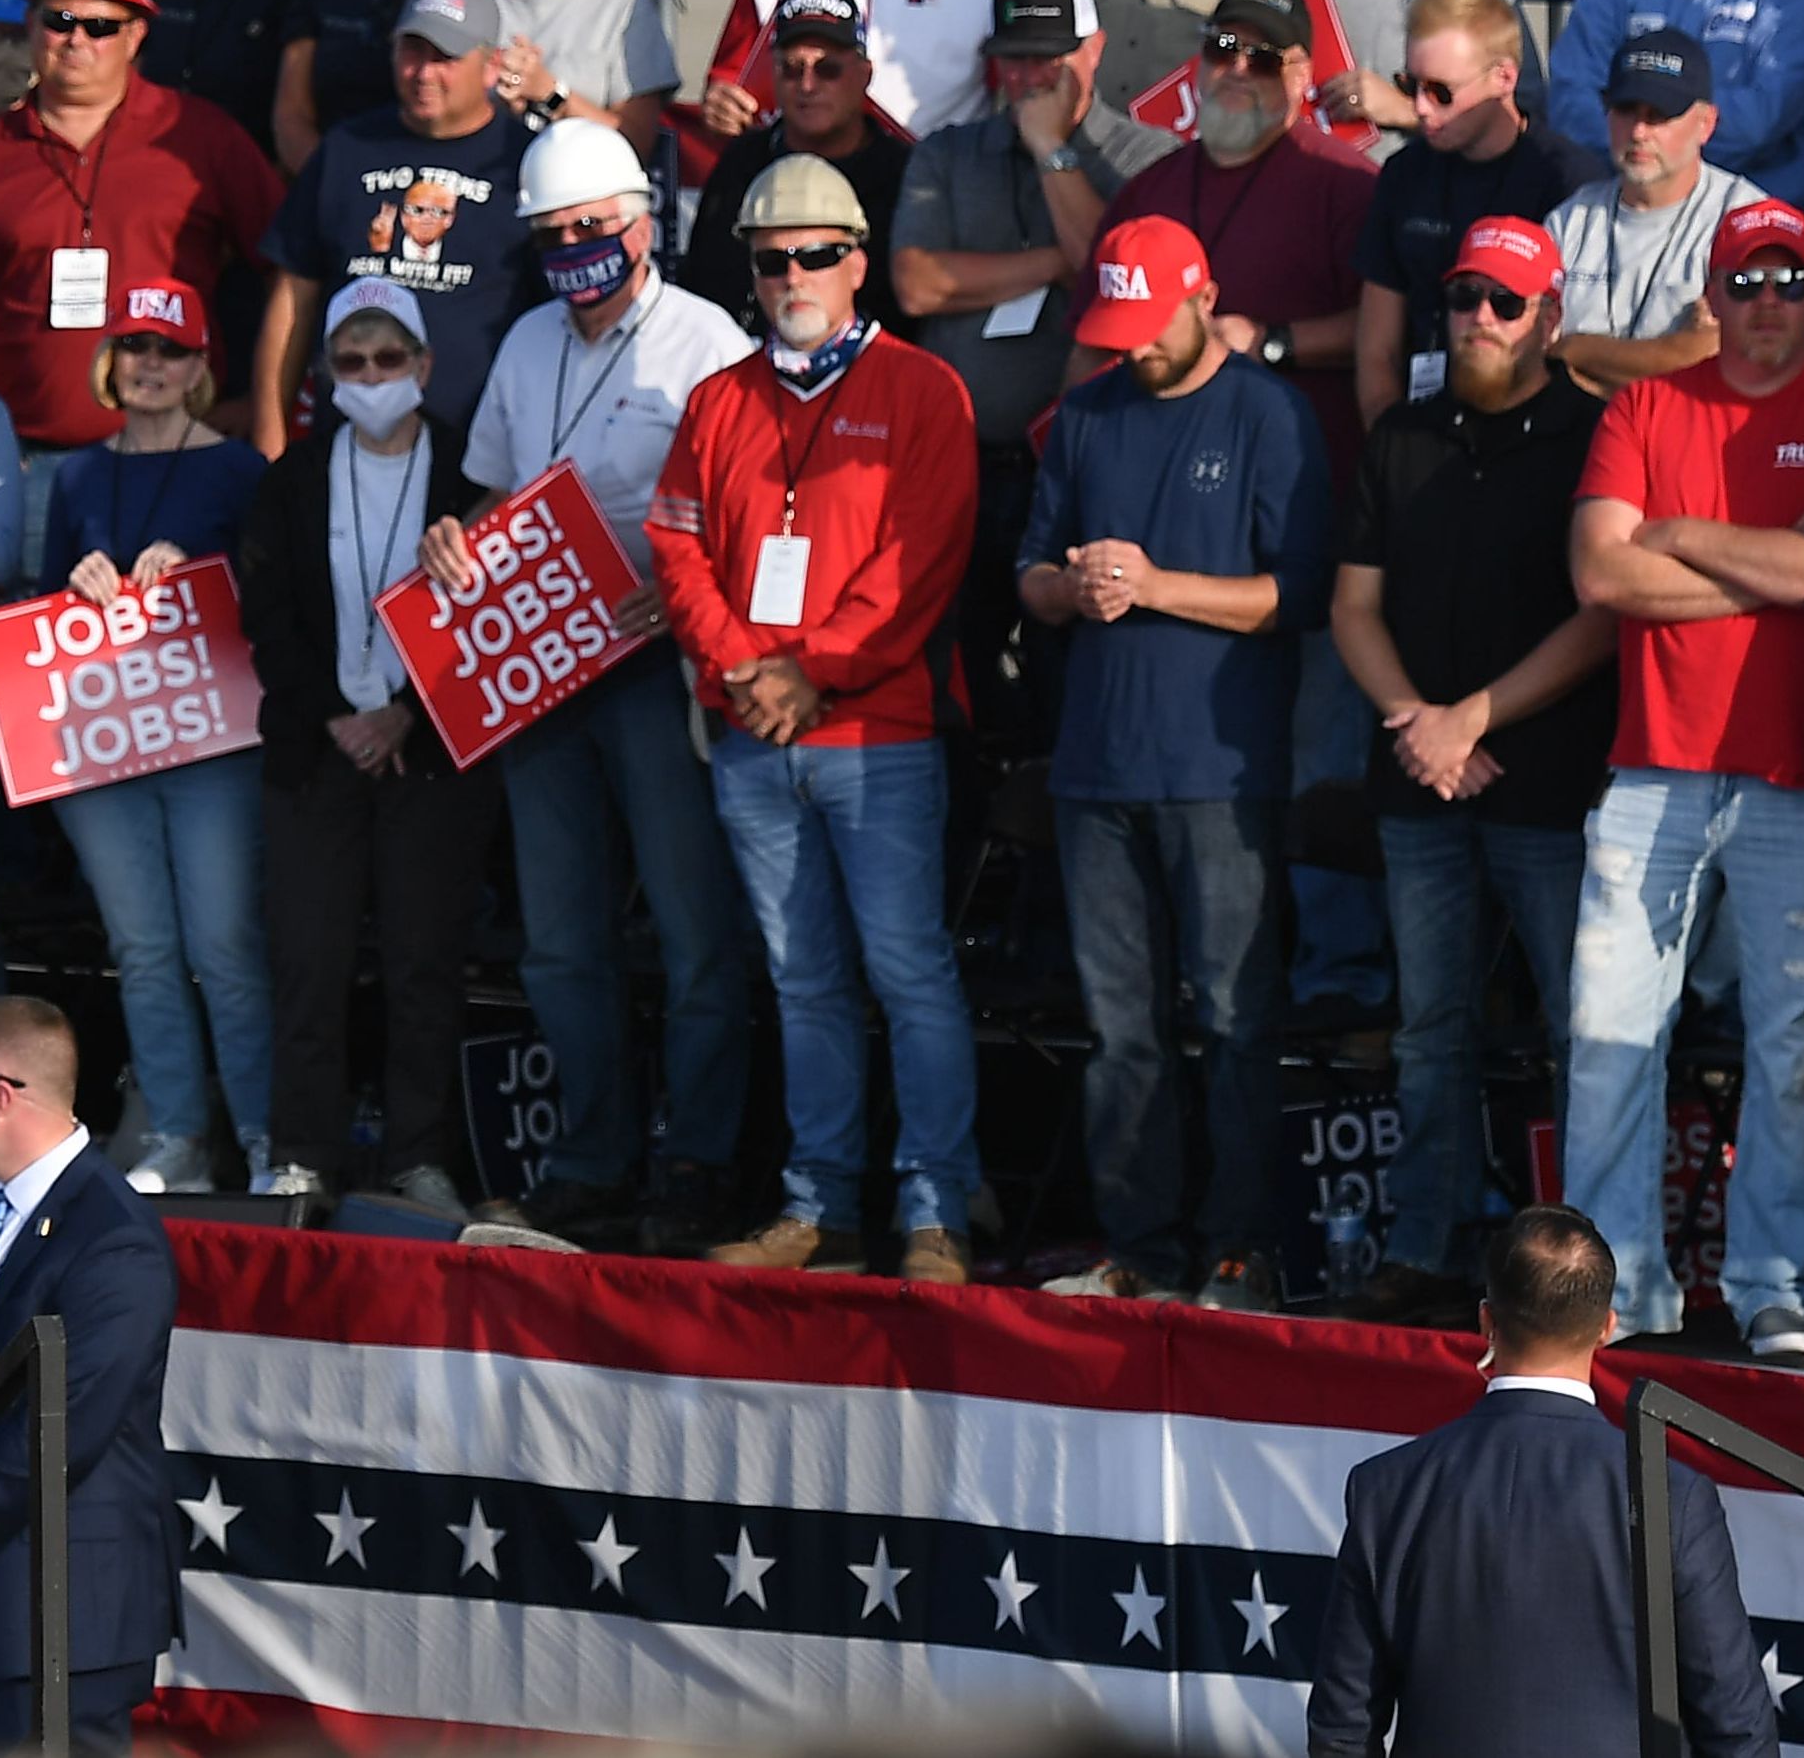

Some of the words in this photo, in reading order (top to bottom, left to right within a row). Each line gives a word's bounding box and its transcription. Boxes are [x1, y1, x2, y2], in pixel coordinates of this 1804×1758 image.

[360, 165, 414, 193] TWO
[127, 287, 185, 327] USA
[546, 251, 624, 292] TRUMP
[1099, 261, 1152, 300] USA
[25, 579, 200, 667] JOBS!
[452, 546, 593, 679] JOBS!
[38, 633, 214, 722] JOBS!
[479, 596, 621, 728] JOBS!
[51, 689, 228, 777] JOBS!
[1301, 1109, 1402, 1166] JOB
